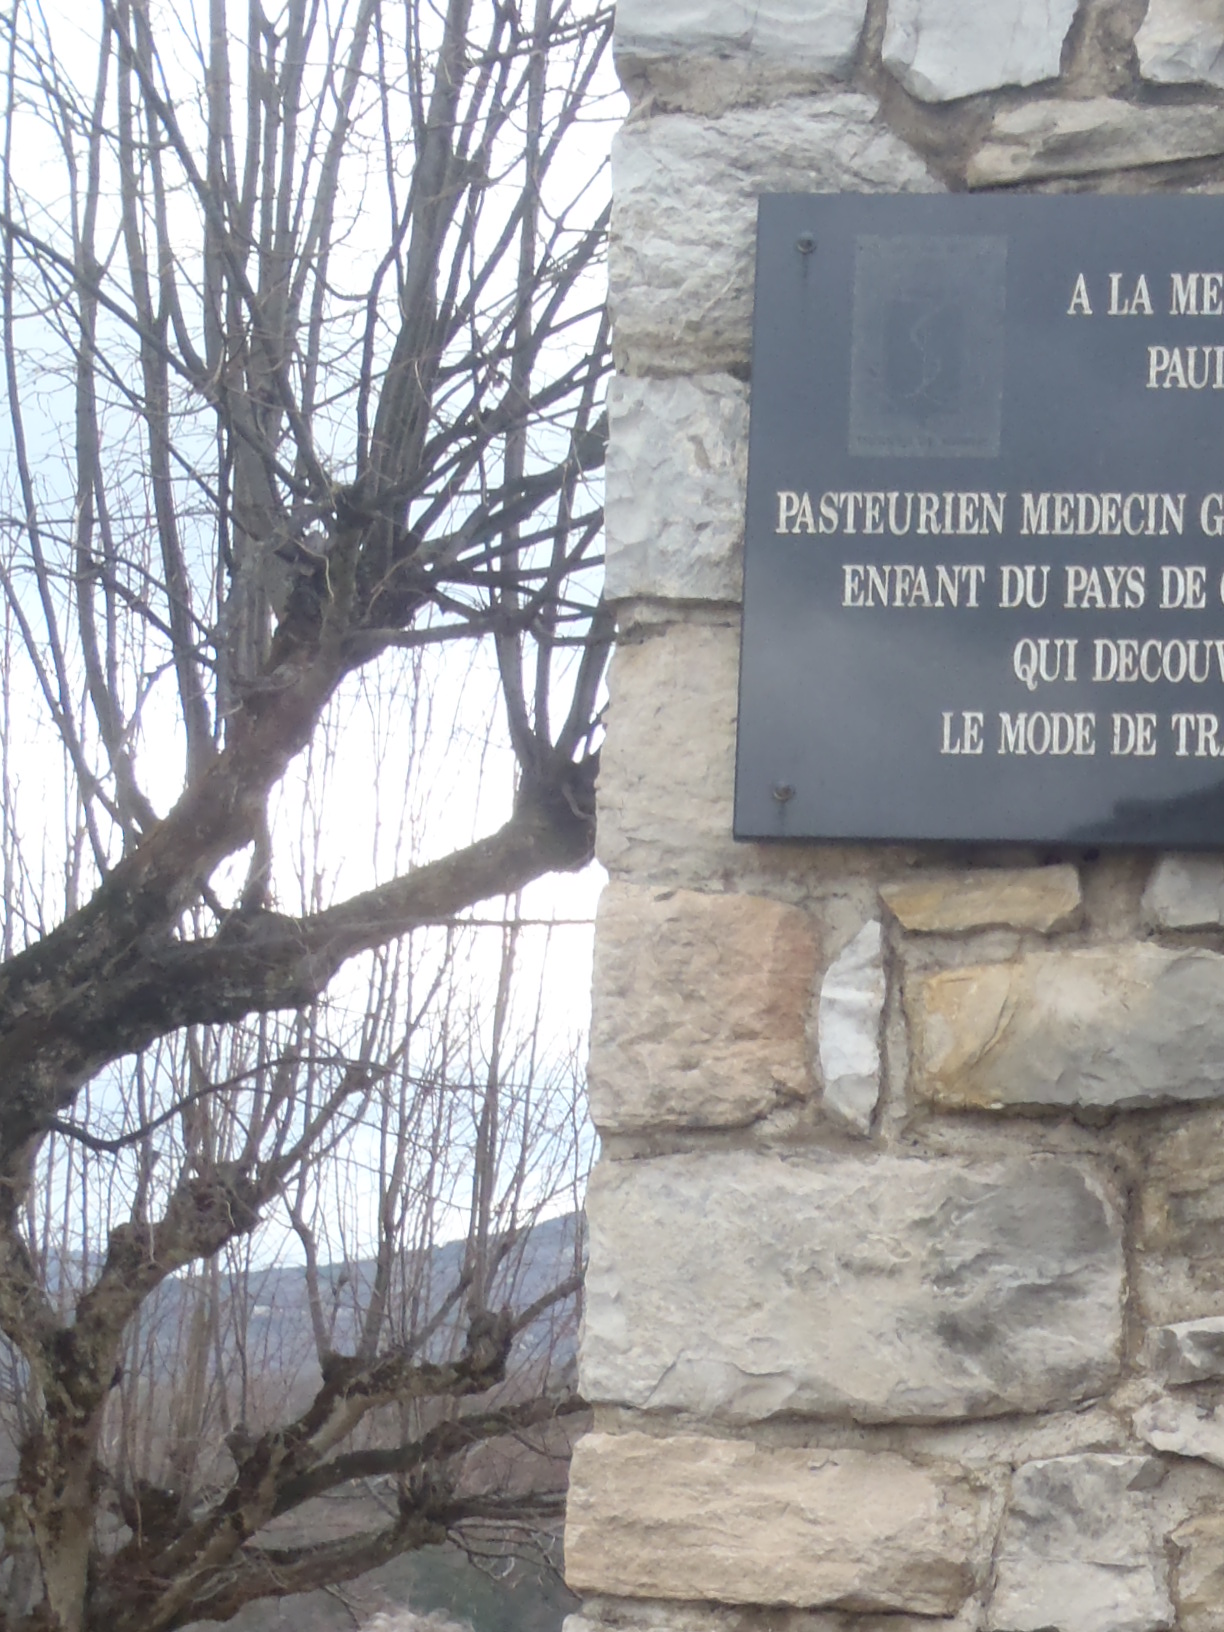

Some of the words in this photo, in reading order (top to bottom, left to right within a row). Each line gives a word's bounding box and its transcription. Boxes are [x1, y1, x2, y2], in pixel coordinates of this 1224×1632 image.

[1067, 272, 1094, 316] A
[1107, 272, 1155, 316] LA
[776, 491, 1007, 536] PASTEURIEN
[1020, 491, 1187, 537] MEDECIN
[841, 563, 986, 608] ENFANT
[998, 564, 1051, 609] DU
[1063, 564, 1146, 609] PAYS
[1158, 565, 1207, 610] DE
[1012, 638, 1079, 691] QUI
[940, 711, 984, 755] LE
[997, 711, 1096, 756] MODE
[1110, 712, 1157, 756] DE
